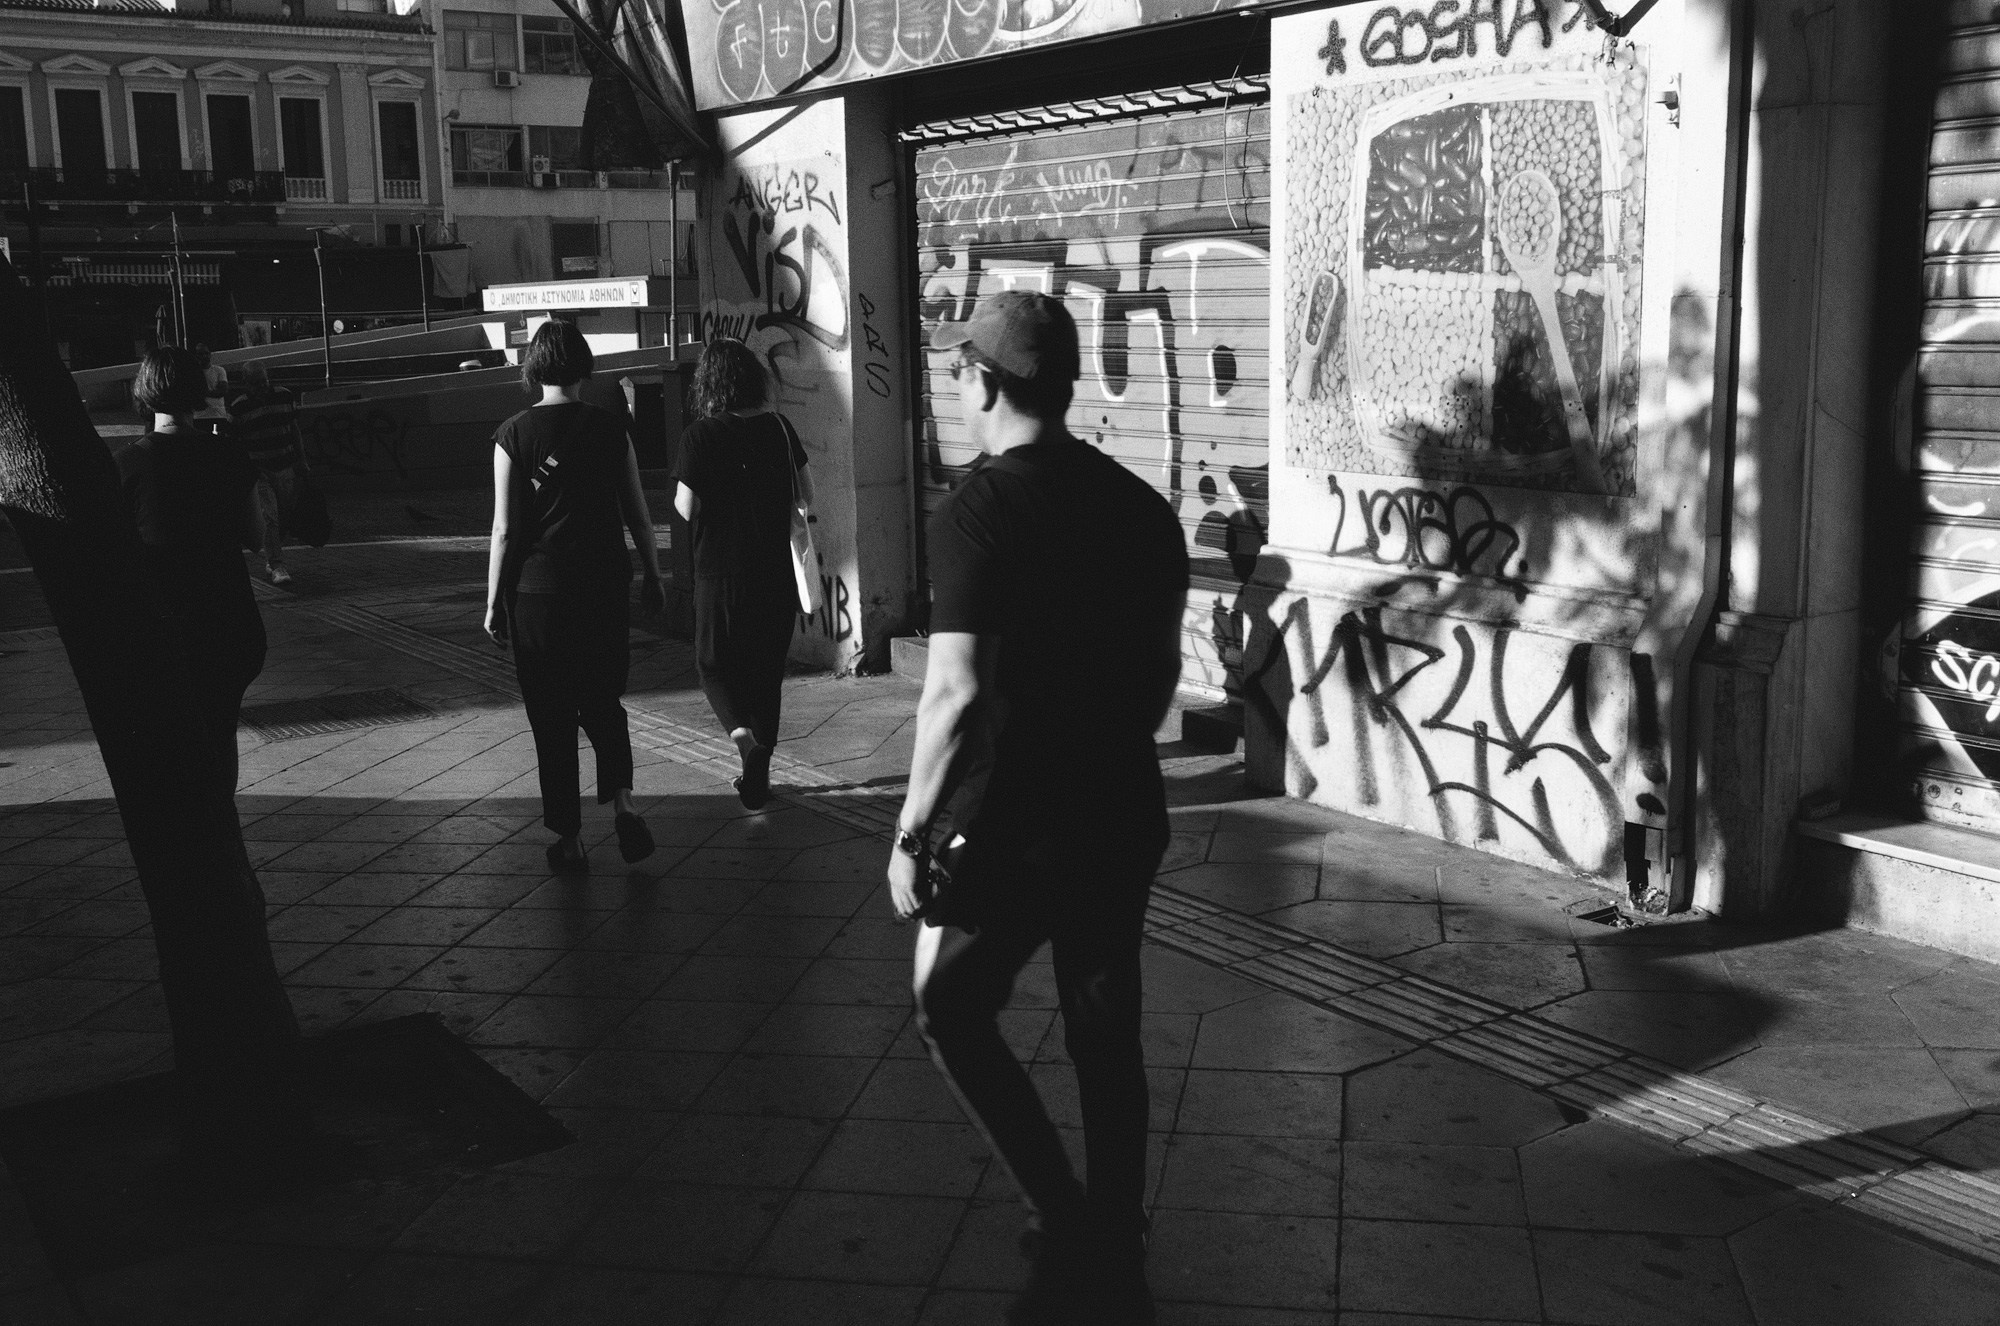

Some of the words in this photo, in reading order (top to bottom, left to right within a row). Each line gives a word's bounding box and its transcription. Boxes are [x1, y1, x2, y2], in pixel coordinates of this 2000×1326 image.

[501, 292, 538, 306] ΔΗΜΟΤΙΚΗ
[541, 290, 585, 304] ΑΣΤΥΝΟΜΙΑ
[589, 287, 625, 302] ΑΘΗΝΩΝ
